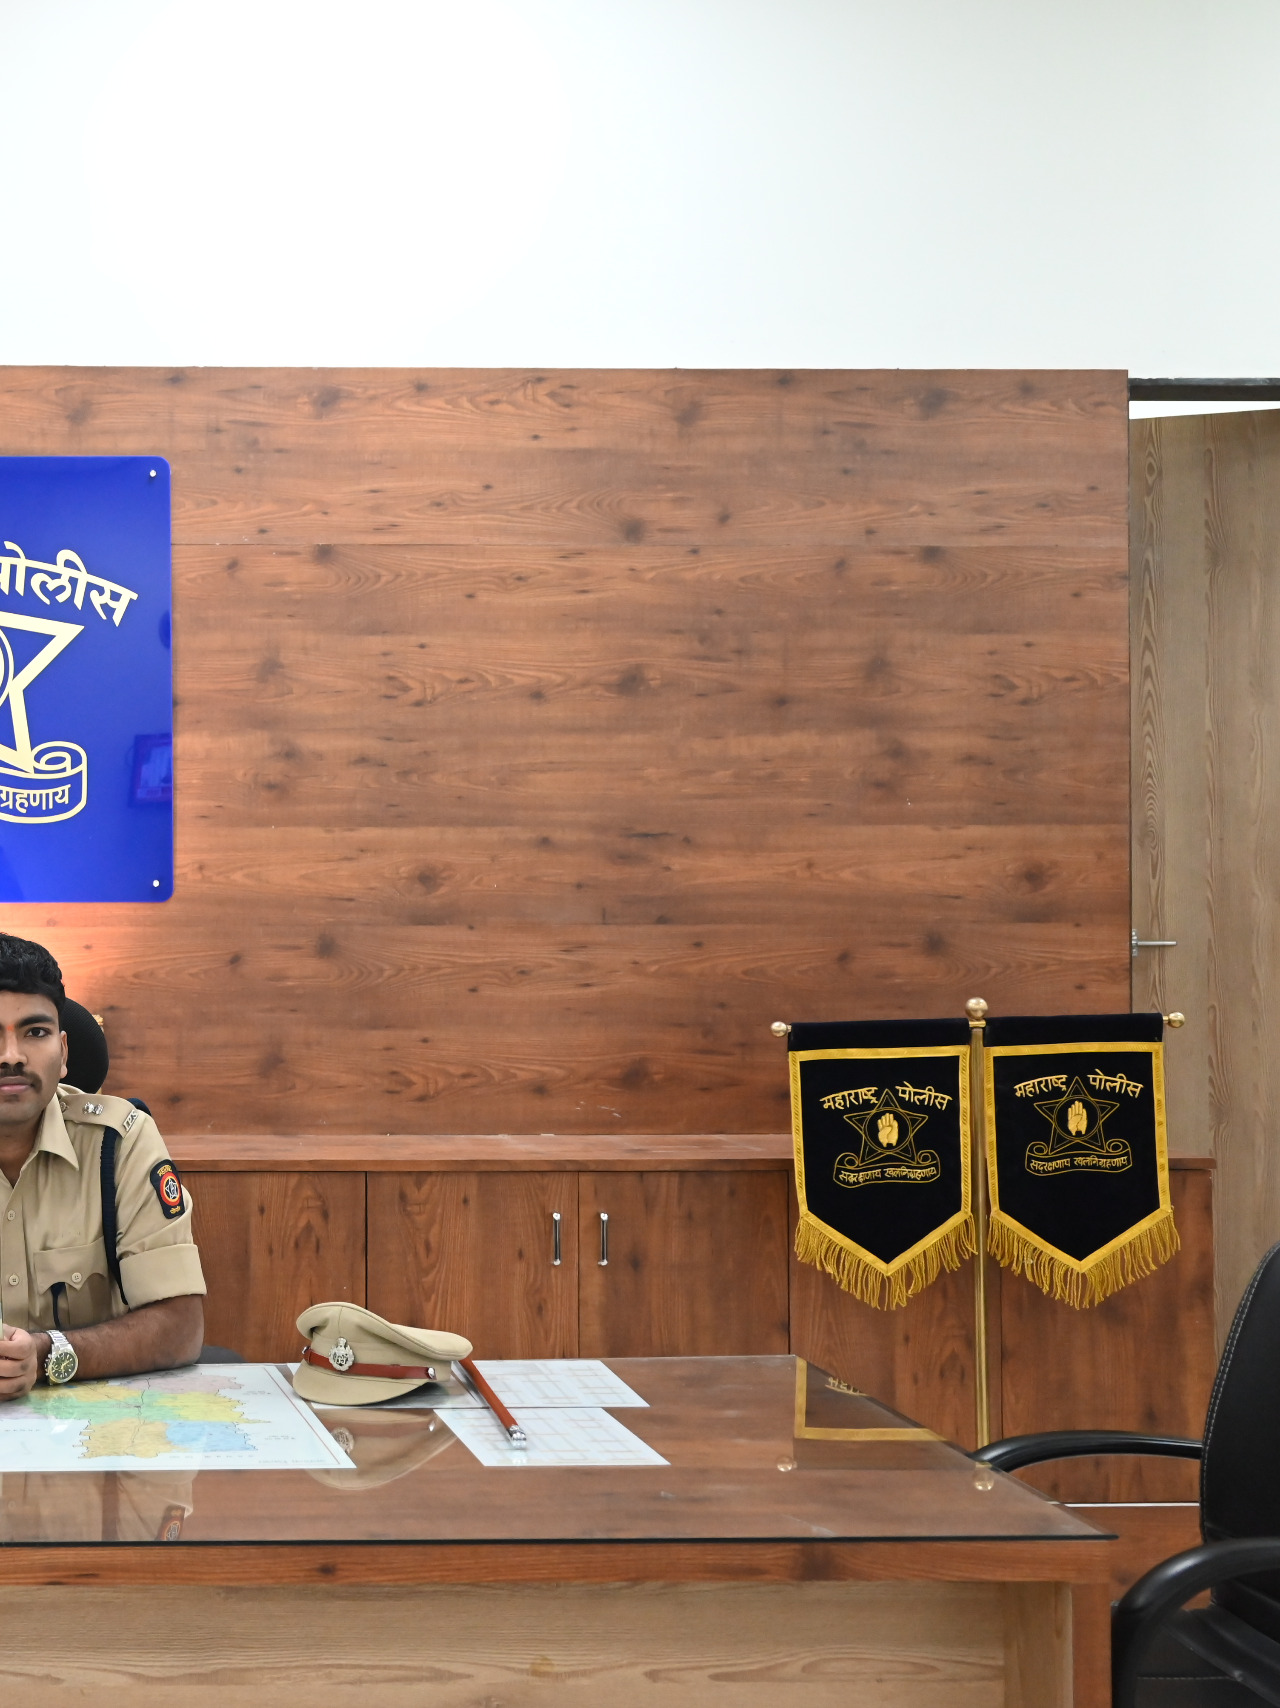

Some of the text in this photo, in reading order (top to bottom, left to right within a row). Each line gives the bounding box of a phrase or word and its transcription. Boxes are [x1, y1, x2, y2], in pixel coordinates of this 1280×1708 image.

[819, 1080, 953, 1111] महाराष्ट्र पोलीस
[1013, 1068, 1144, 1099] महाराष्ट्र पोलीस
